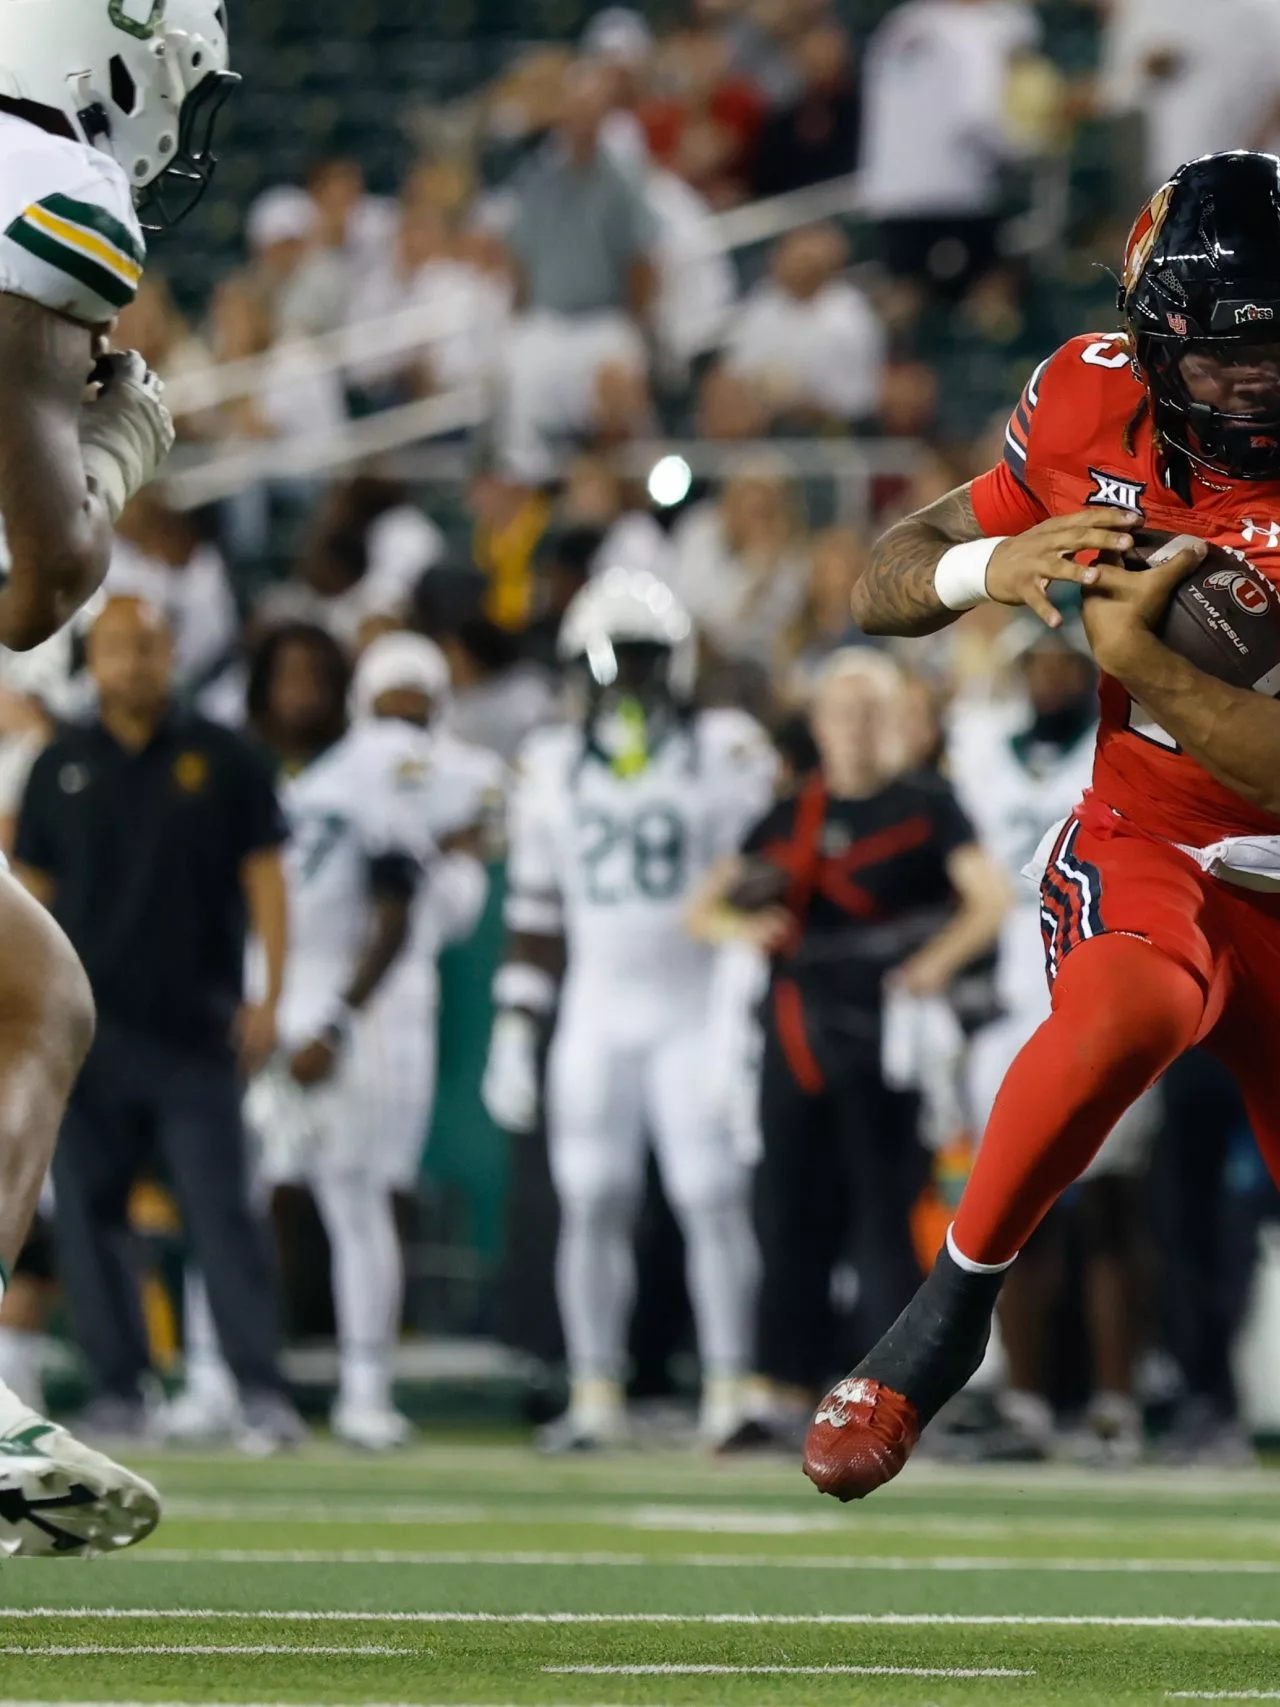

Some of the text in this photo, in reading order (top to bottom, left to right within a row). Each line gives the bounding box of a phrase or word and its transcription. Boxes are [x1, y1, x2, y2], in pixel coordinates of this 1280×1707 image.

[1188, 585, 1249, 654] TEAM ISSUE
[575, 803, 690, 905] 28
